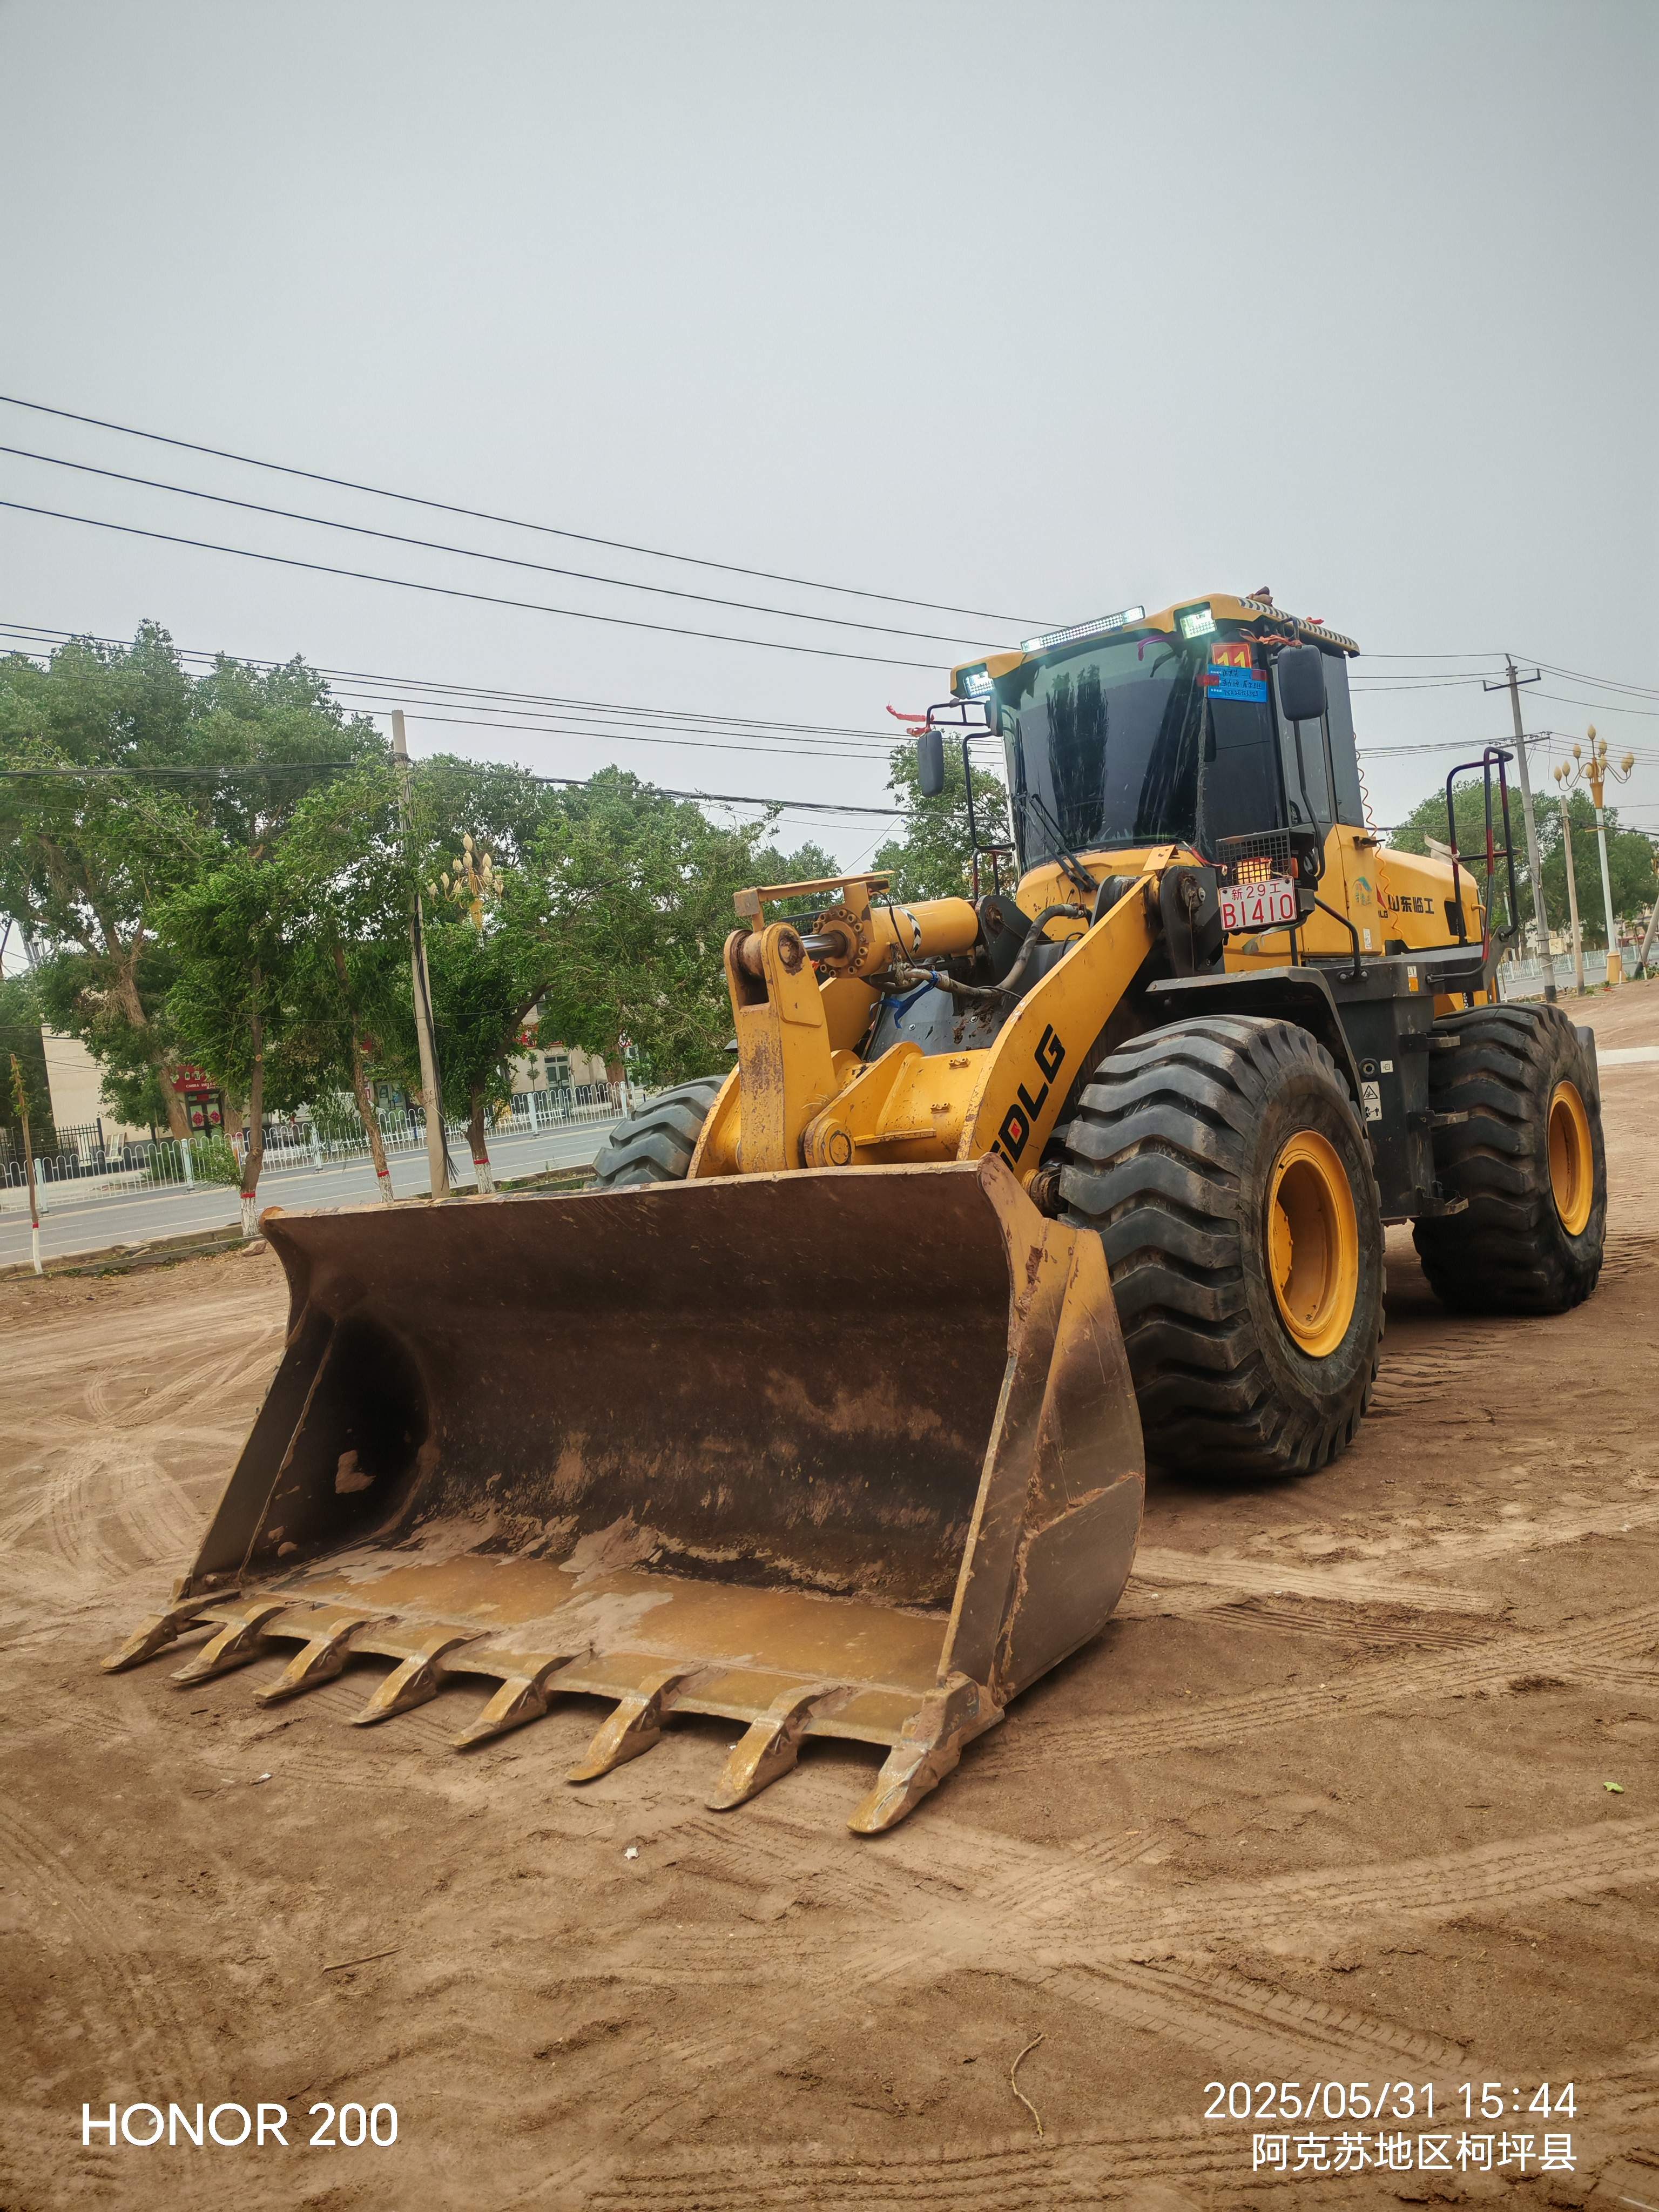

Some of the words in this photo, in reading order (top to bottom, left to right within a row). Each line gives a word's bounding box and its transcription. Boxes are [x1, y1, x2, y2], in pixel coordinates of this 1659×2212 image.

[1218, 651, 1246, 669] 11
[1231, 883, 1282, 901] 新29工
[1223, 894, 1293, 928] B1410
[1388, 894, 1434, 914] 山东临工
[1378, 910, 1388, 918] LG
